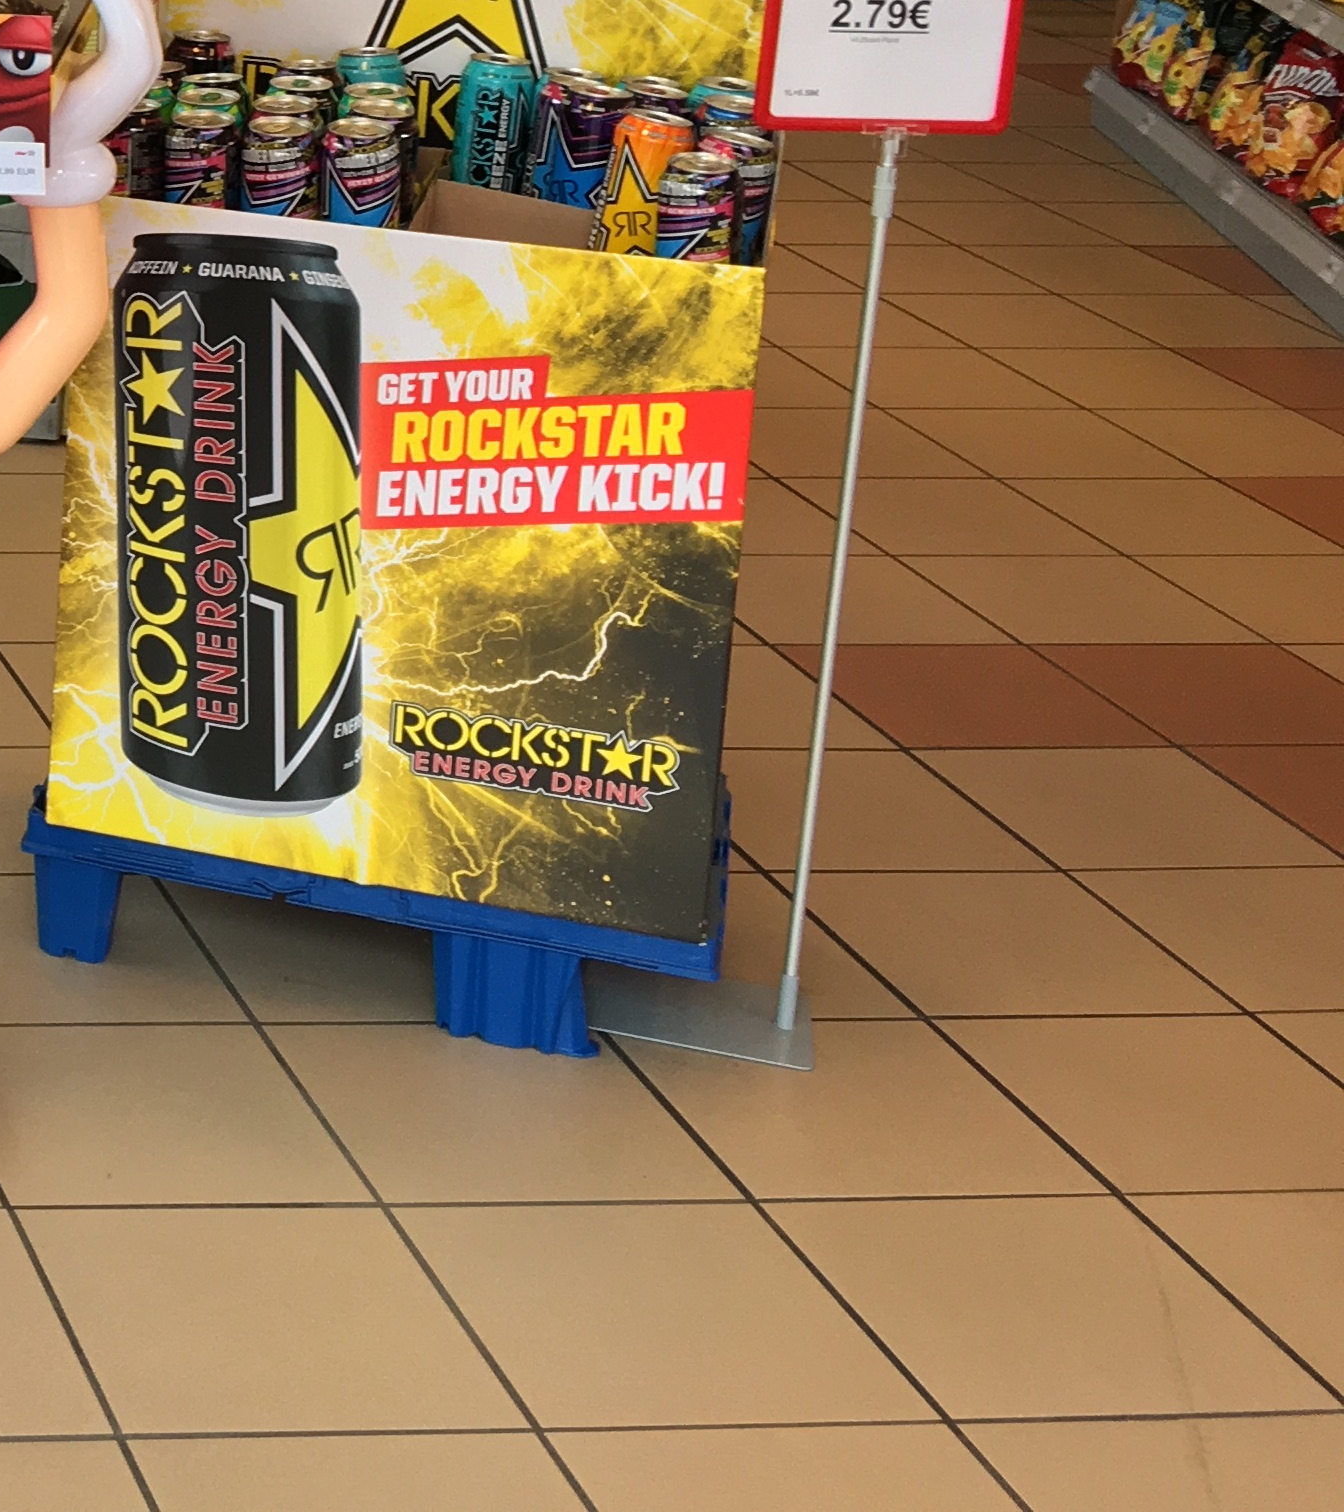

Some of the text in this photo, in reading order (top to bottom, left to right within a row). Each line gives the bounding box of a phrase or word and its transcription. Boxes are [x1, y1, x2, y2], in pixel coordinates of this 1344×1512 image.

[830, 0, 933, 30] 2.79€
[197, 261, 286, 284] GUARANA
[377, 366, 534, 405] GET YOUR
[389, 401, 689, 465] ROCKSTAR
[375, 462, 725, 519] ENERGY KICK!
[193, 338, 240, 726] ENERGY DRINK
[412, 750, 653, 808] ENERGY DRINK
